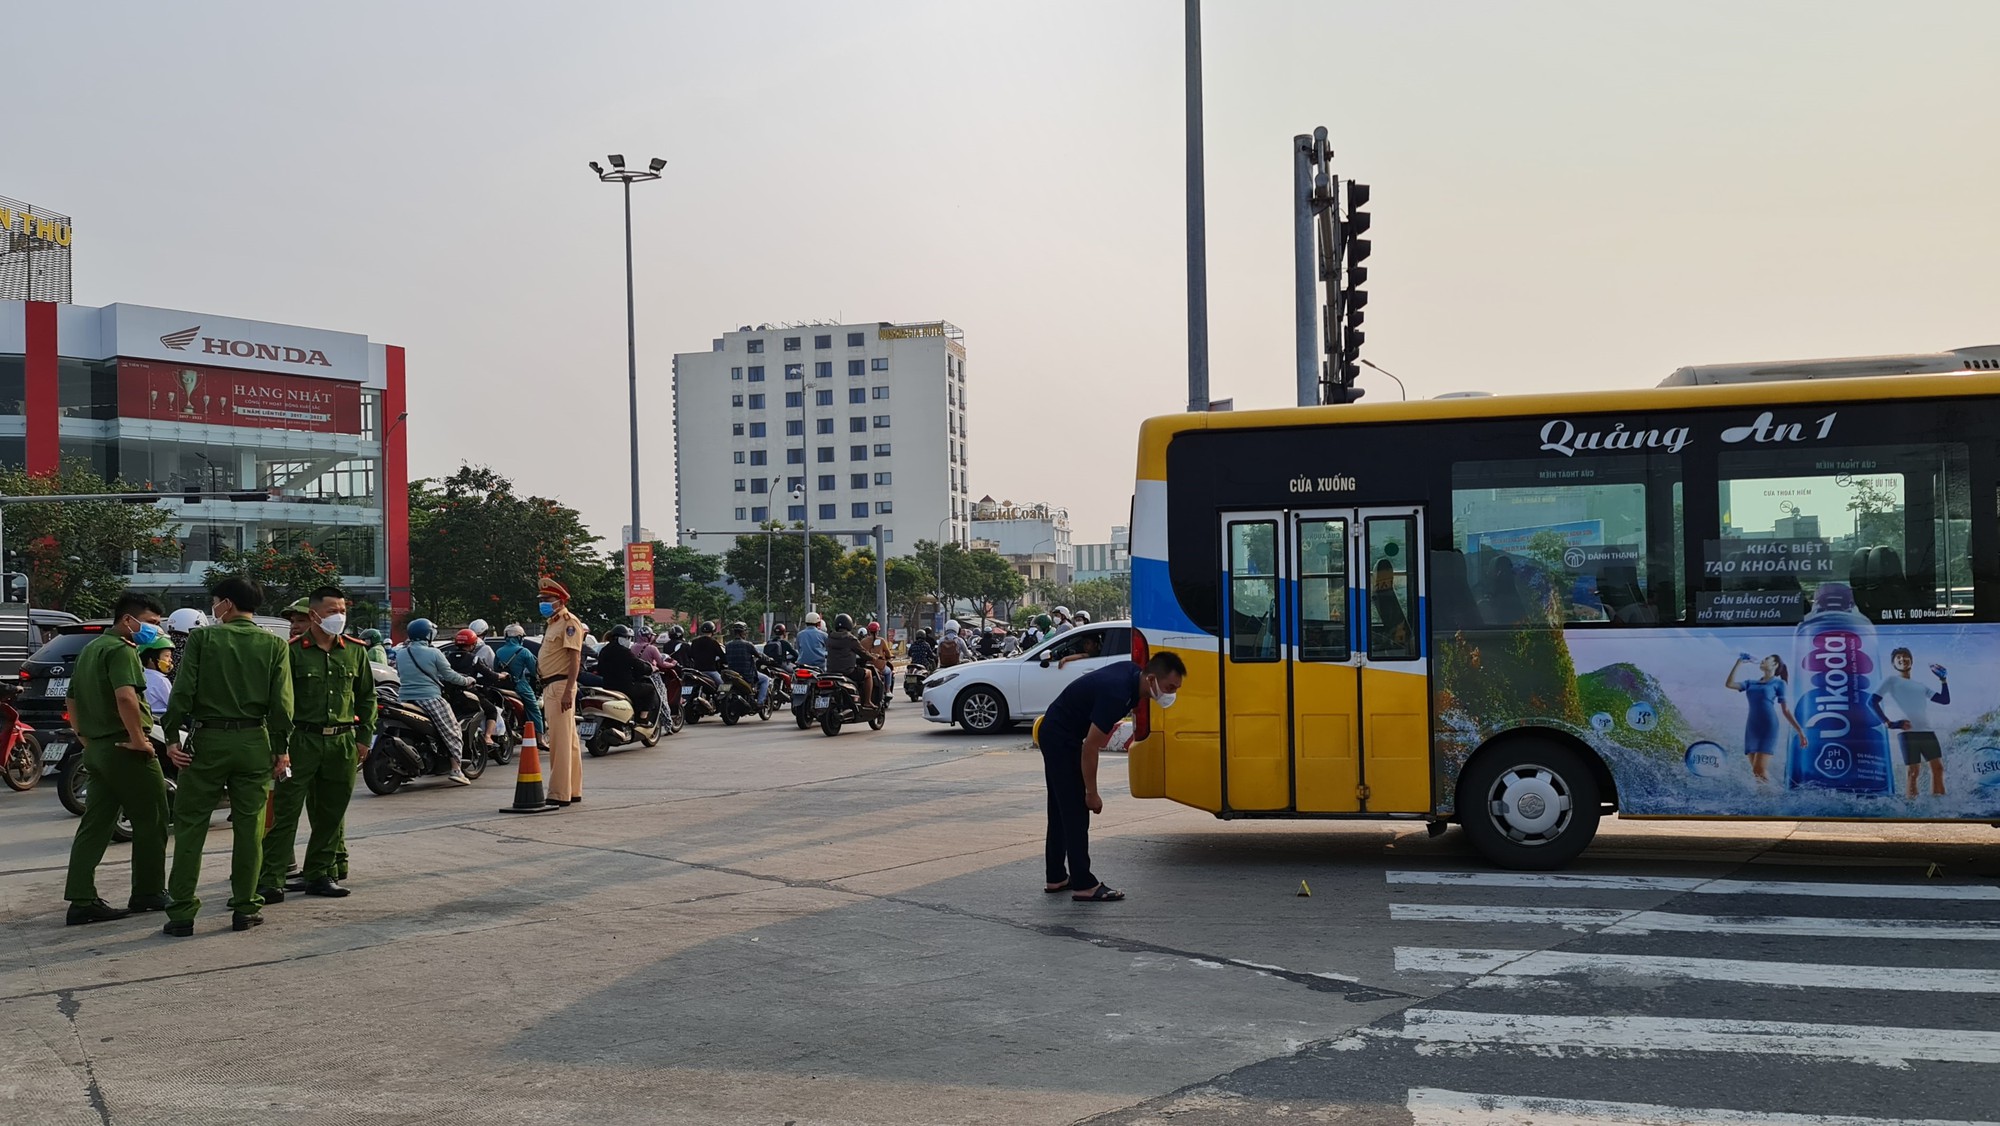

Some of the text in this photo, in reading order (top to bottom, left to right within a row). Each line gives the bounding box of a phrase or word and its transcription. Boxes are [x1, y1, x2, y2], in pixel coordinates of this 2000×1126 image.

[201, 337, 332, 367] HONDA
[234, 384, 332, 403] HẠNG NHẤT
[1540, 411, 1838, 457] Quảng An 1
[1289, 473, 1356, 493] CỬA XUỐNG
[1747, 541, 1823, 556] KHÁC BIỆT
[1705, 560, 1736, 575] TẠO
[1740, 557, 1812, 572] KHOÁNG
[1713, 592, 1802, 604] CÂN BẰNG CƠ THỂ
[1698, 607, 1781, 620] HỖ TRỢ TIÊU HÓA
[1827, 748, 1841, 758] pH
[1824, 758, 1845, 770] 9.0
